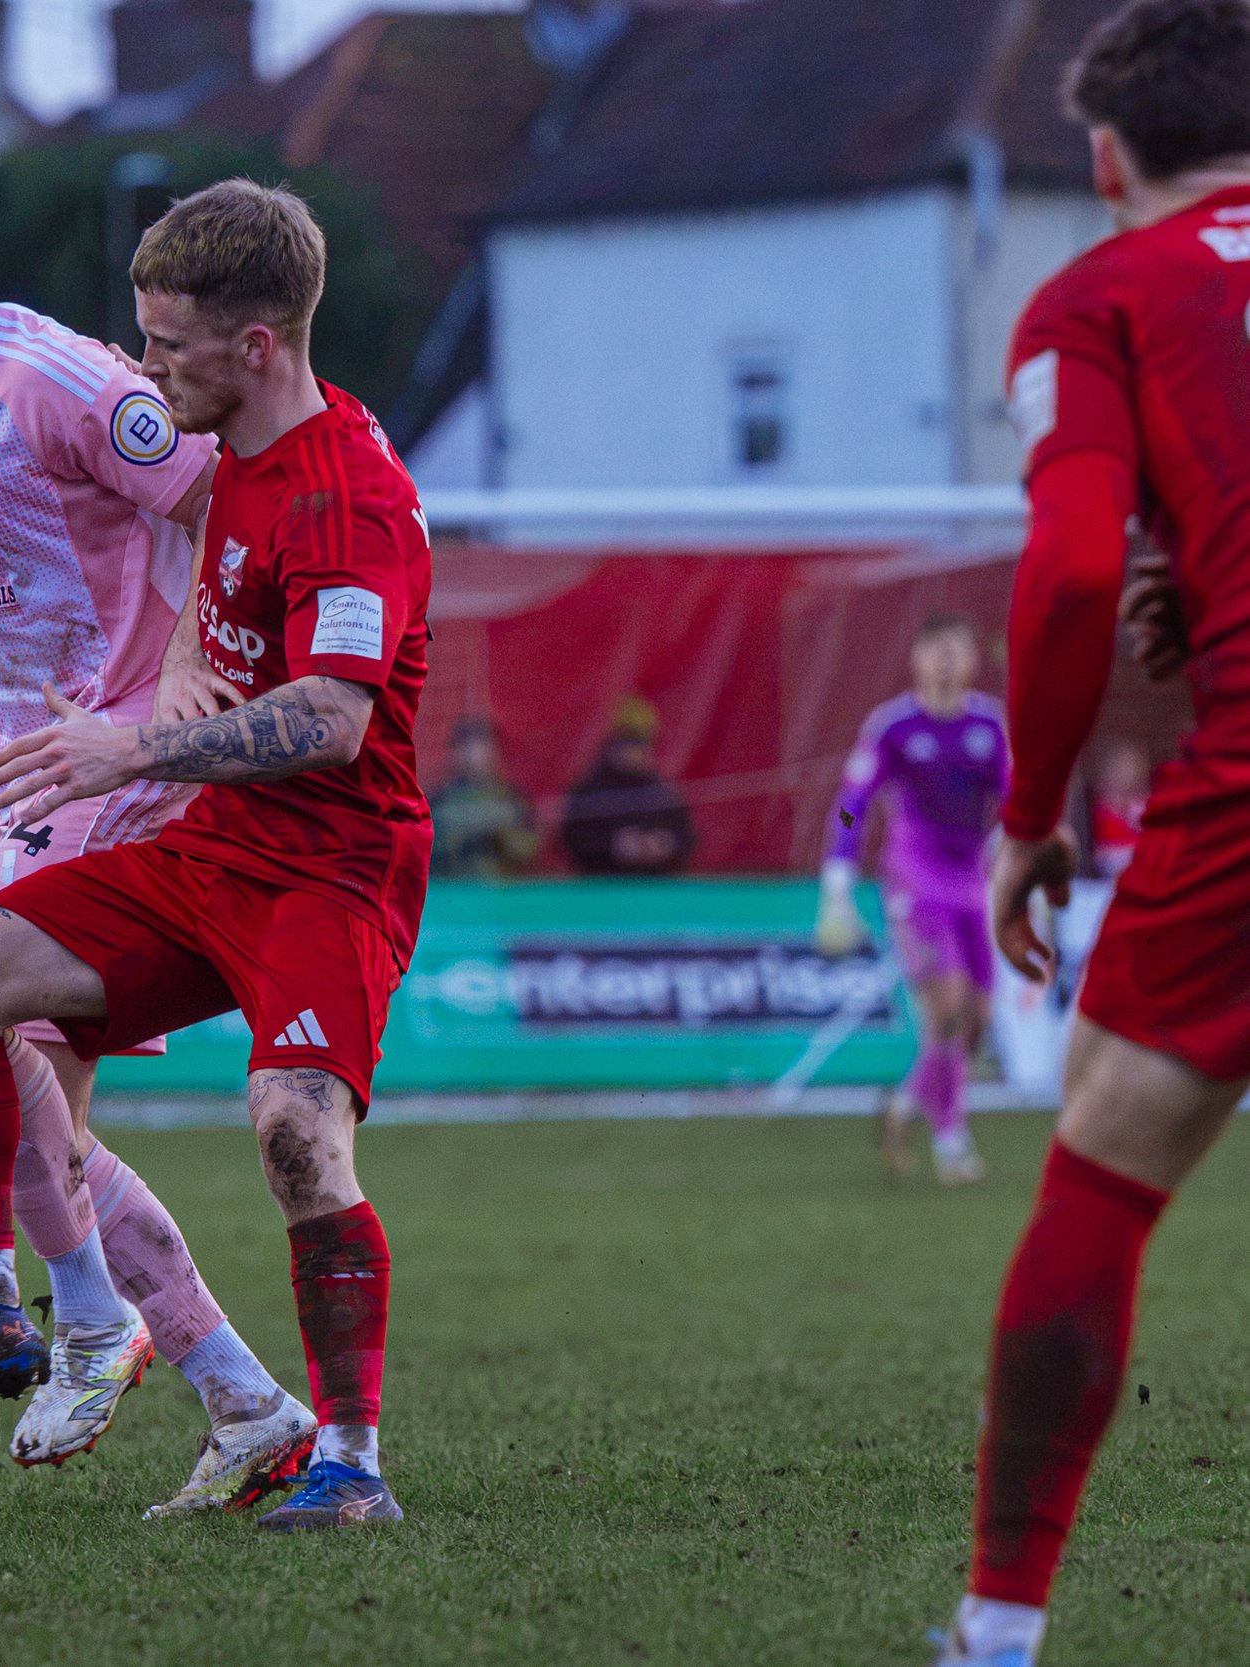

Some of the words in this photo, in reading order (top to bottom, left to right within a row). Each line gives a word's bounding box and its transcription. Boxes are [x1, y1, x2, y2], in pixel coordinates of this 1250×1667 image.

[129, 412, 160, 447] B
[331, 601, 358, 611] Smart
[359, 601, 381, 616] Door
[318, 618, 364, 631] Solutions
[365, 622, 380, 634] Ltd
